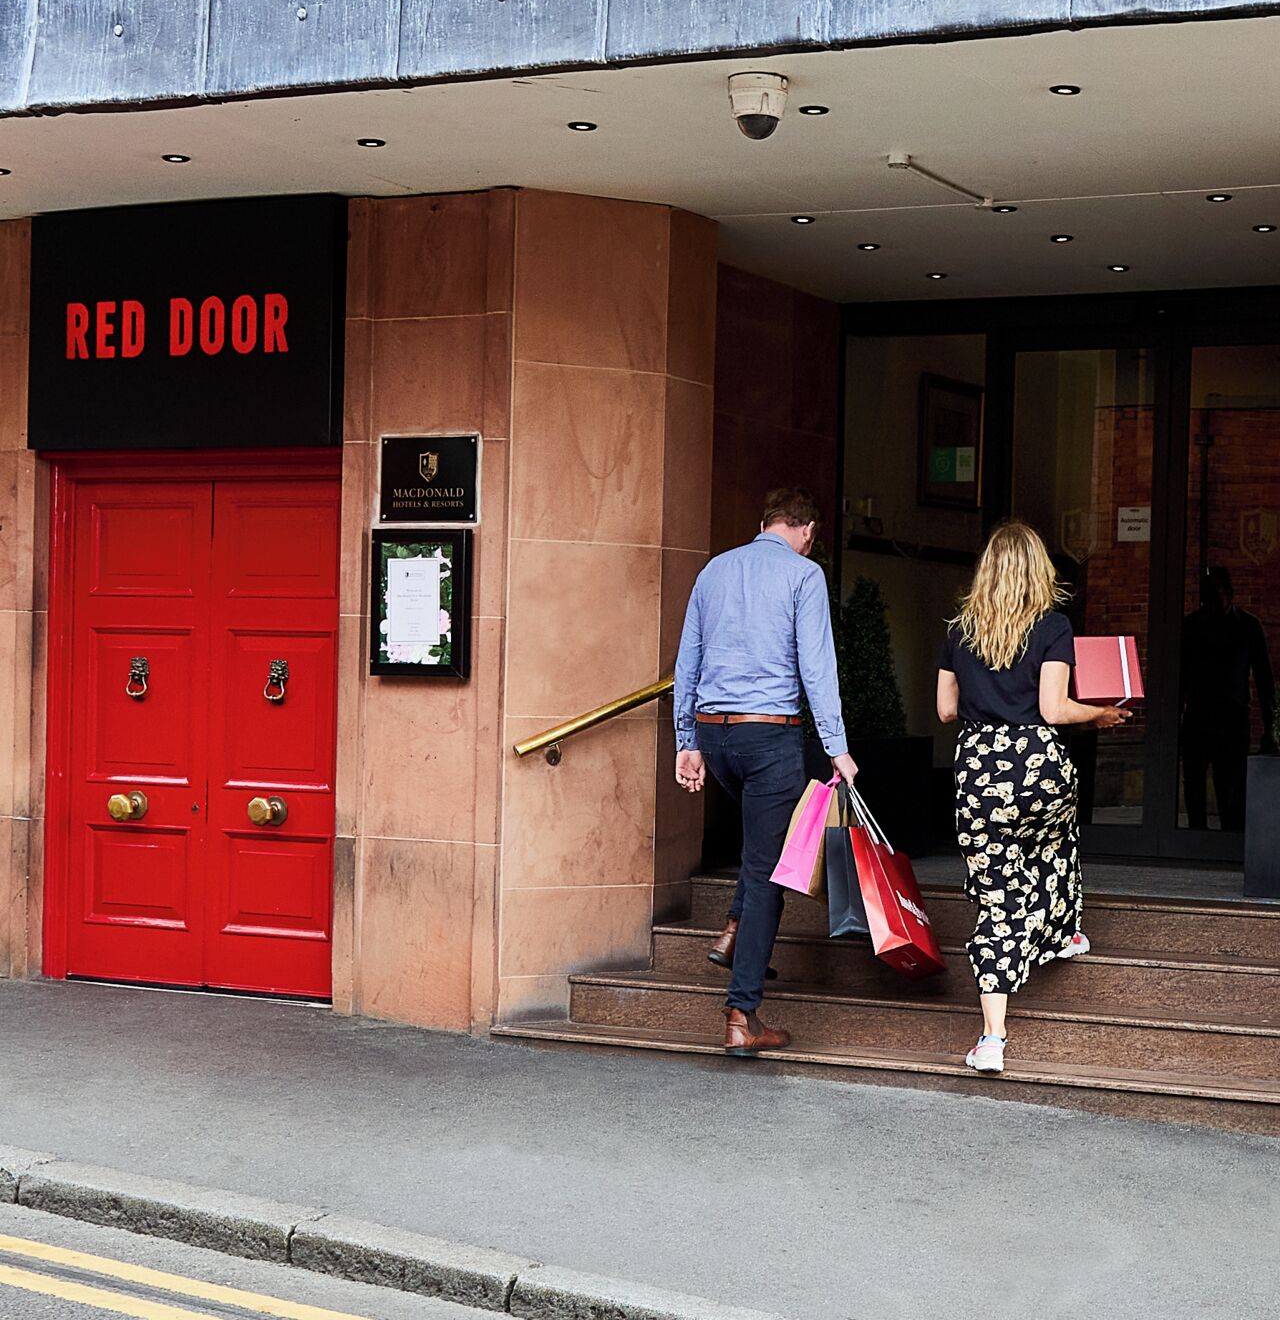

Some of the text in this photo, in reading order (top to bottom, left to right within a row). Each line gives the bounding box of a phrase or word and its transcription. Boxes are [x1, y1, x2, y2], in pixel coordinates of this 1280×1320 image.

[65, 293, 289, 360] RED DOOR
[392, 488, 464, 498] MACDONALD
[392, 500, 421, 508] HOTELS
[431, 500, 464, 508] RESORTS
